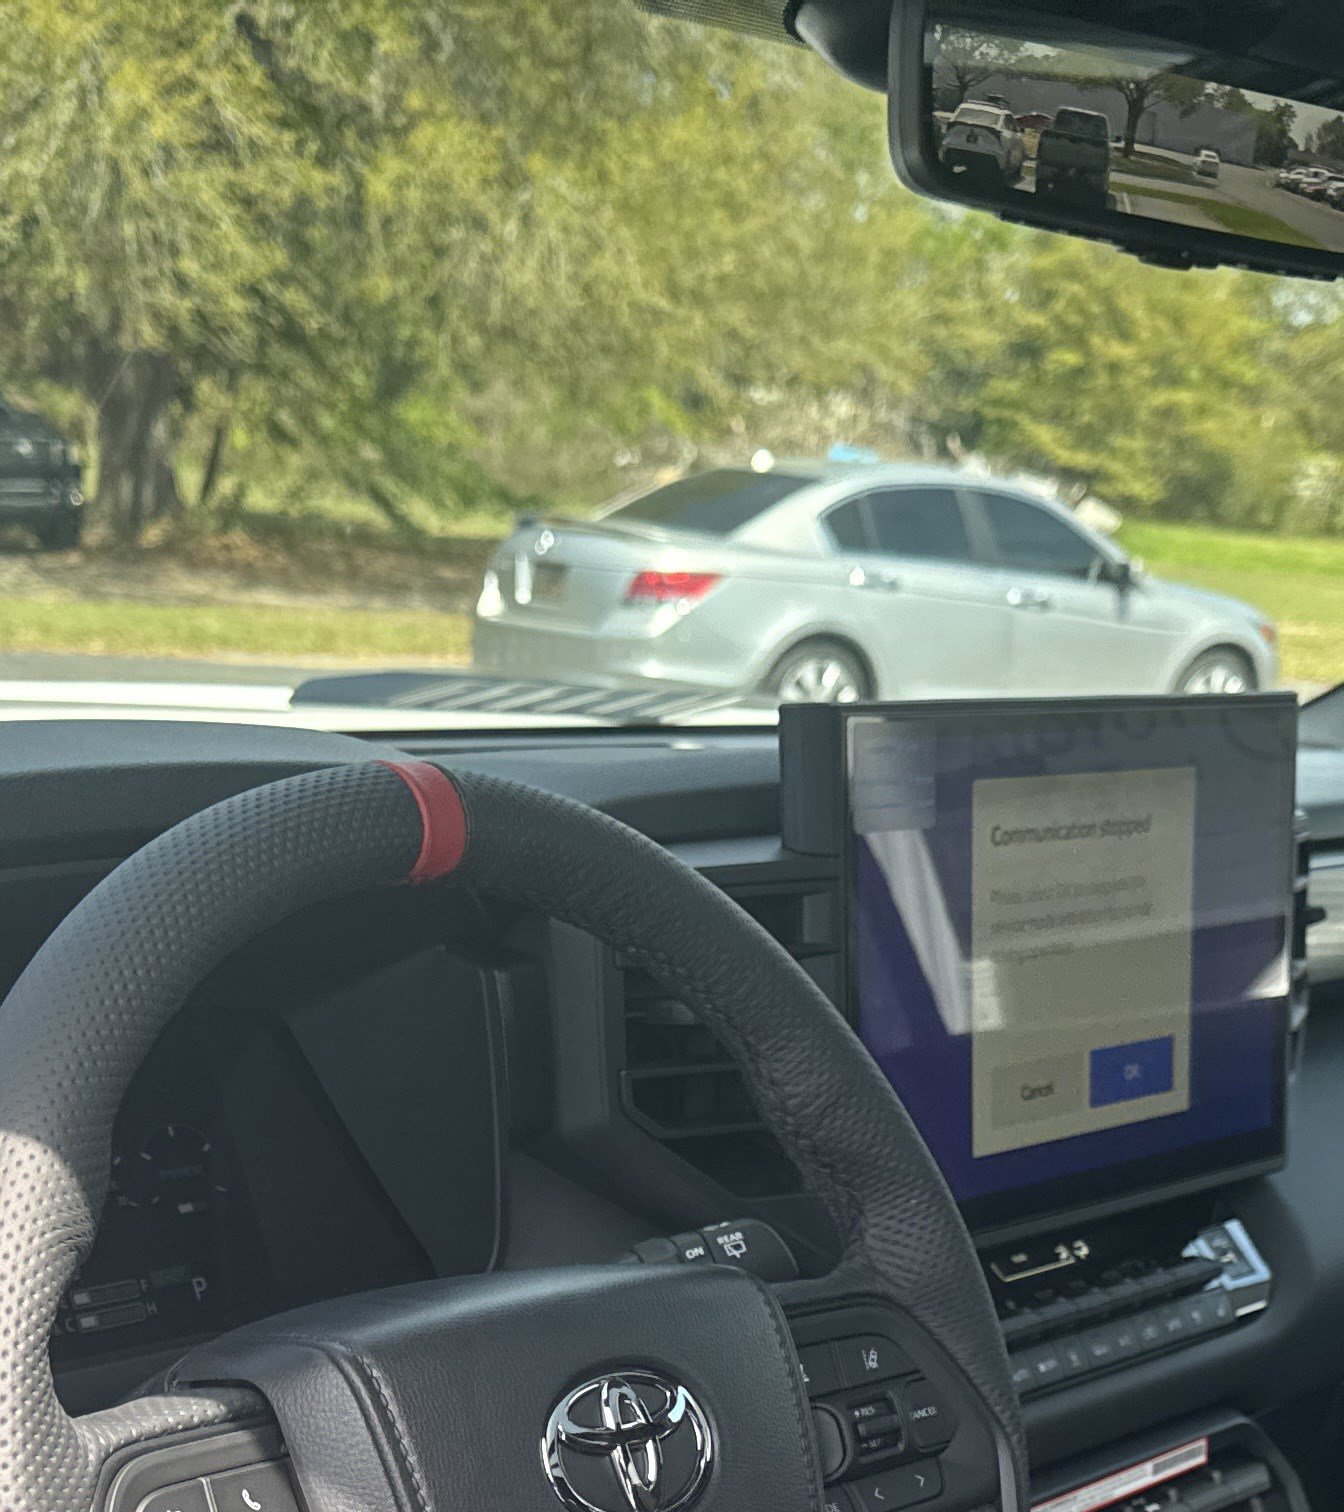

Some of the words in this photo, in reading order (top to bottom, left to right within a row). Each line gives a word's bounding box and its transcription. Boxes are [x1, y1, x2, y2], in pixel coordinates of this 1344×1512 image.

[990, 825, 1097, 846] Communication
[1100, 813, 1152, 840] stopped
[1021, 1081, 1054, 1101] Cancel
[716, 1231, 744, 1245] REAR
[685, 1246, 705, 1259] ON
[192, 1277, 208, 1301] P
